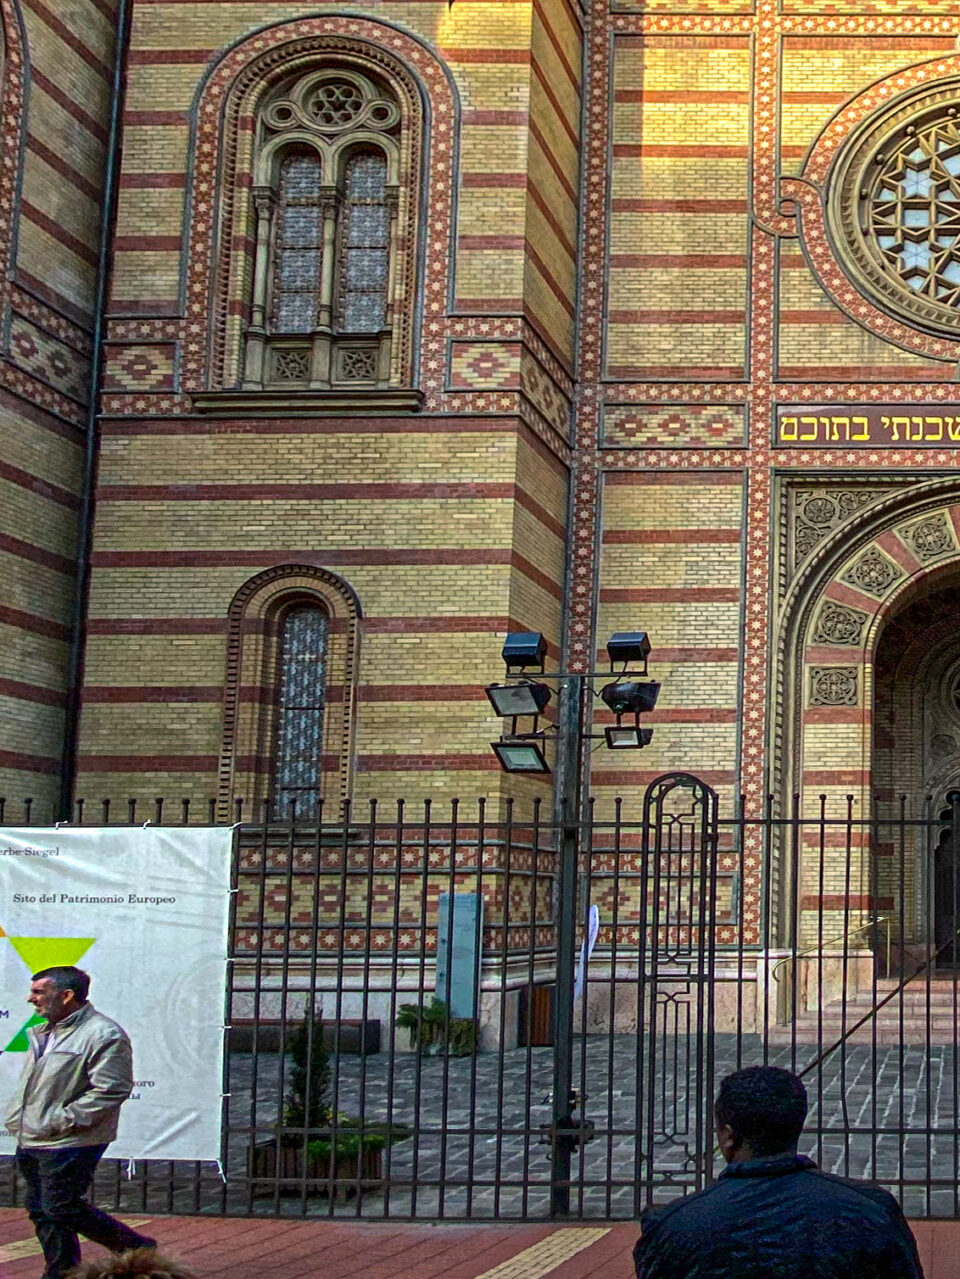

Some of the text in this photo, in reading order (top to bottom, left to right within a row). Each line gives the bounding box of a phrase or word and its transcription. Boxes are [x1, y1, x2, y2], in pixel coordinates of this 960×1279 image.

[779, 416, 871, 441] בתוכם
[12, 893, 176, 906] Sito del Patrimonio Europeo
